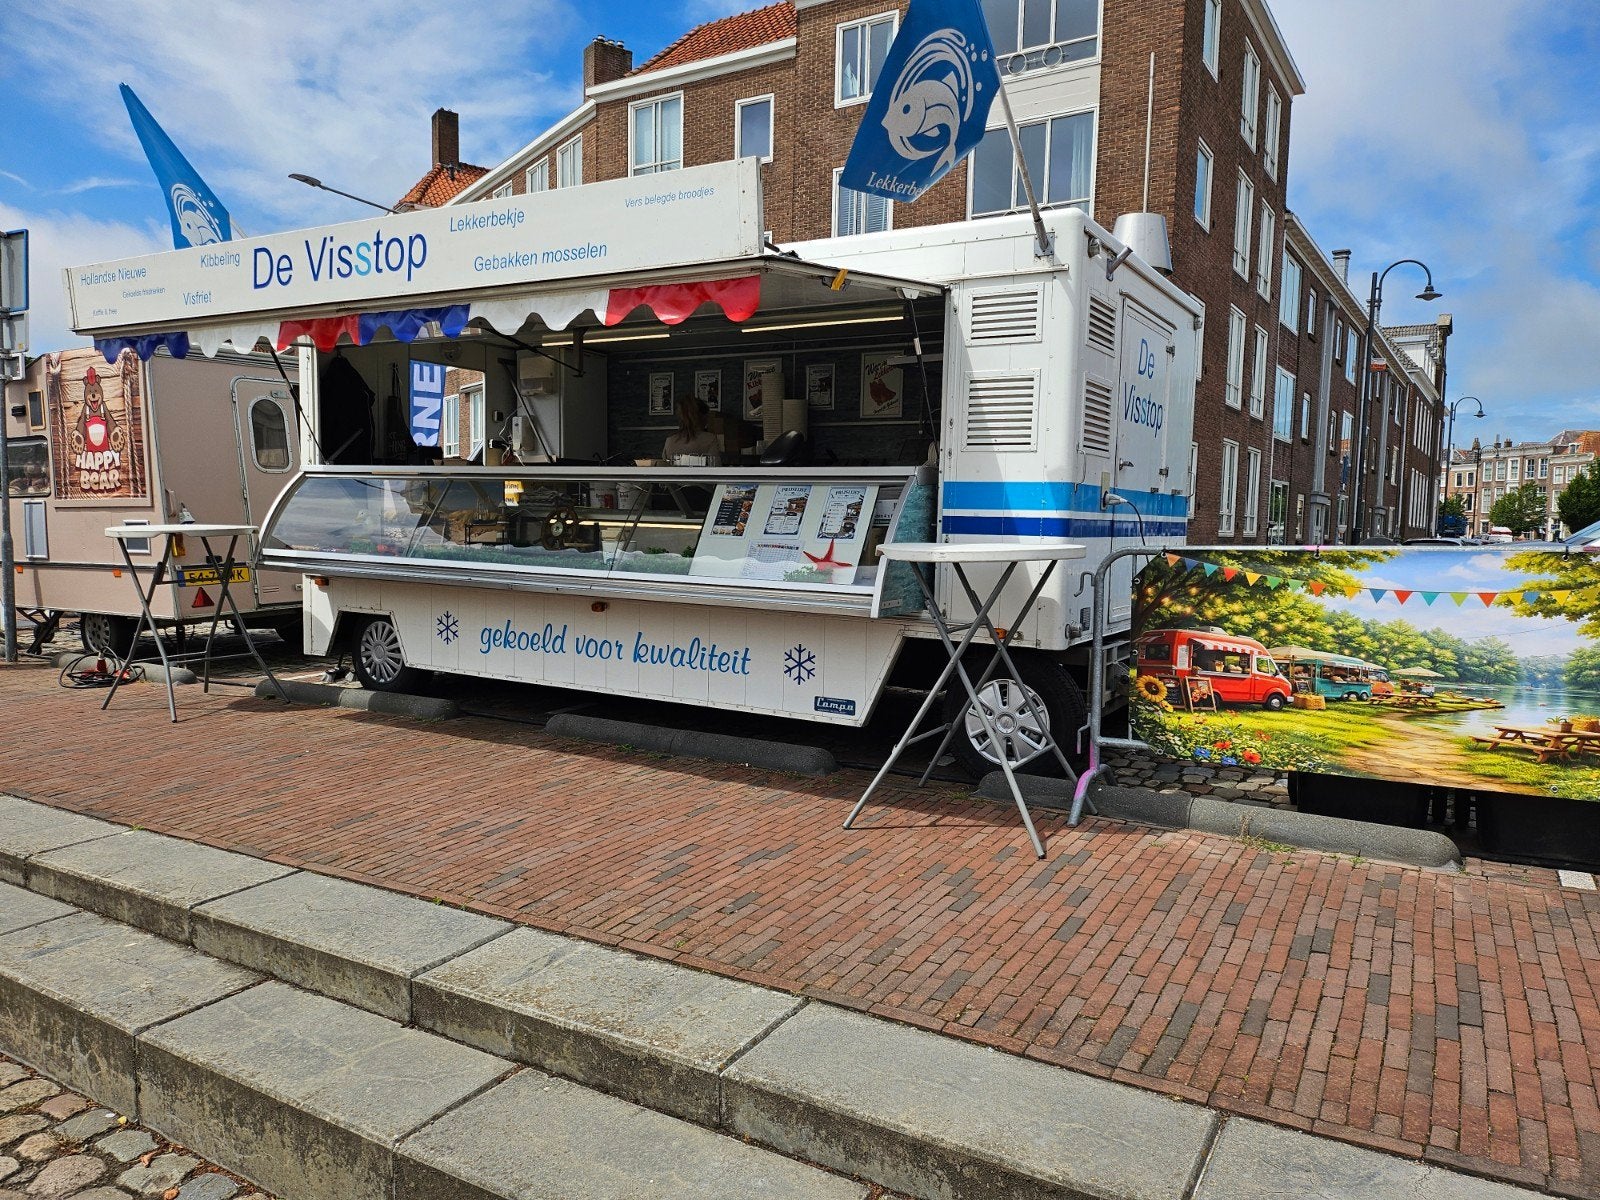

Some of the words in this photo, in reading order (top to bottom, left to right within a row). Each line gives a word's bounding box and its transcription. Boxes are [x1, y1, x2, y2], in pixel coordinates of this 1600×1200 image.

[625, 198, 642, 208] Vers
[645, 192, 676, 205] belegde
[679, 186, 715, 200] broodjes
[450, 207, 525, 232] Lekkerbekje
[200, 252, 241, 268] Kibbeling
[253, 247, 293, 289] De
[304, 229, 427, 282] Visstop
[474, 251, 538, 272] Gebakken
[541, 242, 607, 263] mosselen
[80, 270, 116, 287] Hollandse
[118, 266, 147, 281] Nieuwe
[183, 291, 212, 306] Visfriet
[1137, 338, 1155, 380] De
[1123, 381, 1163, 438] Visstop
[75, 450, 121, 470] HAPPY
[479, 619, 568, 654] gekoeld
[575, 635, 623, 660] voor
[633, 631, 751, 675] kwaliteit
